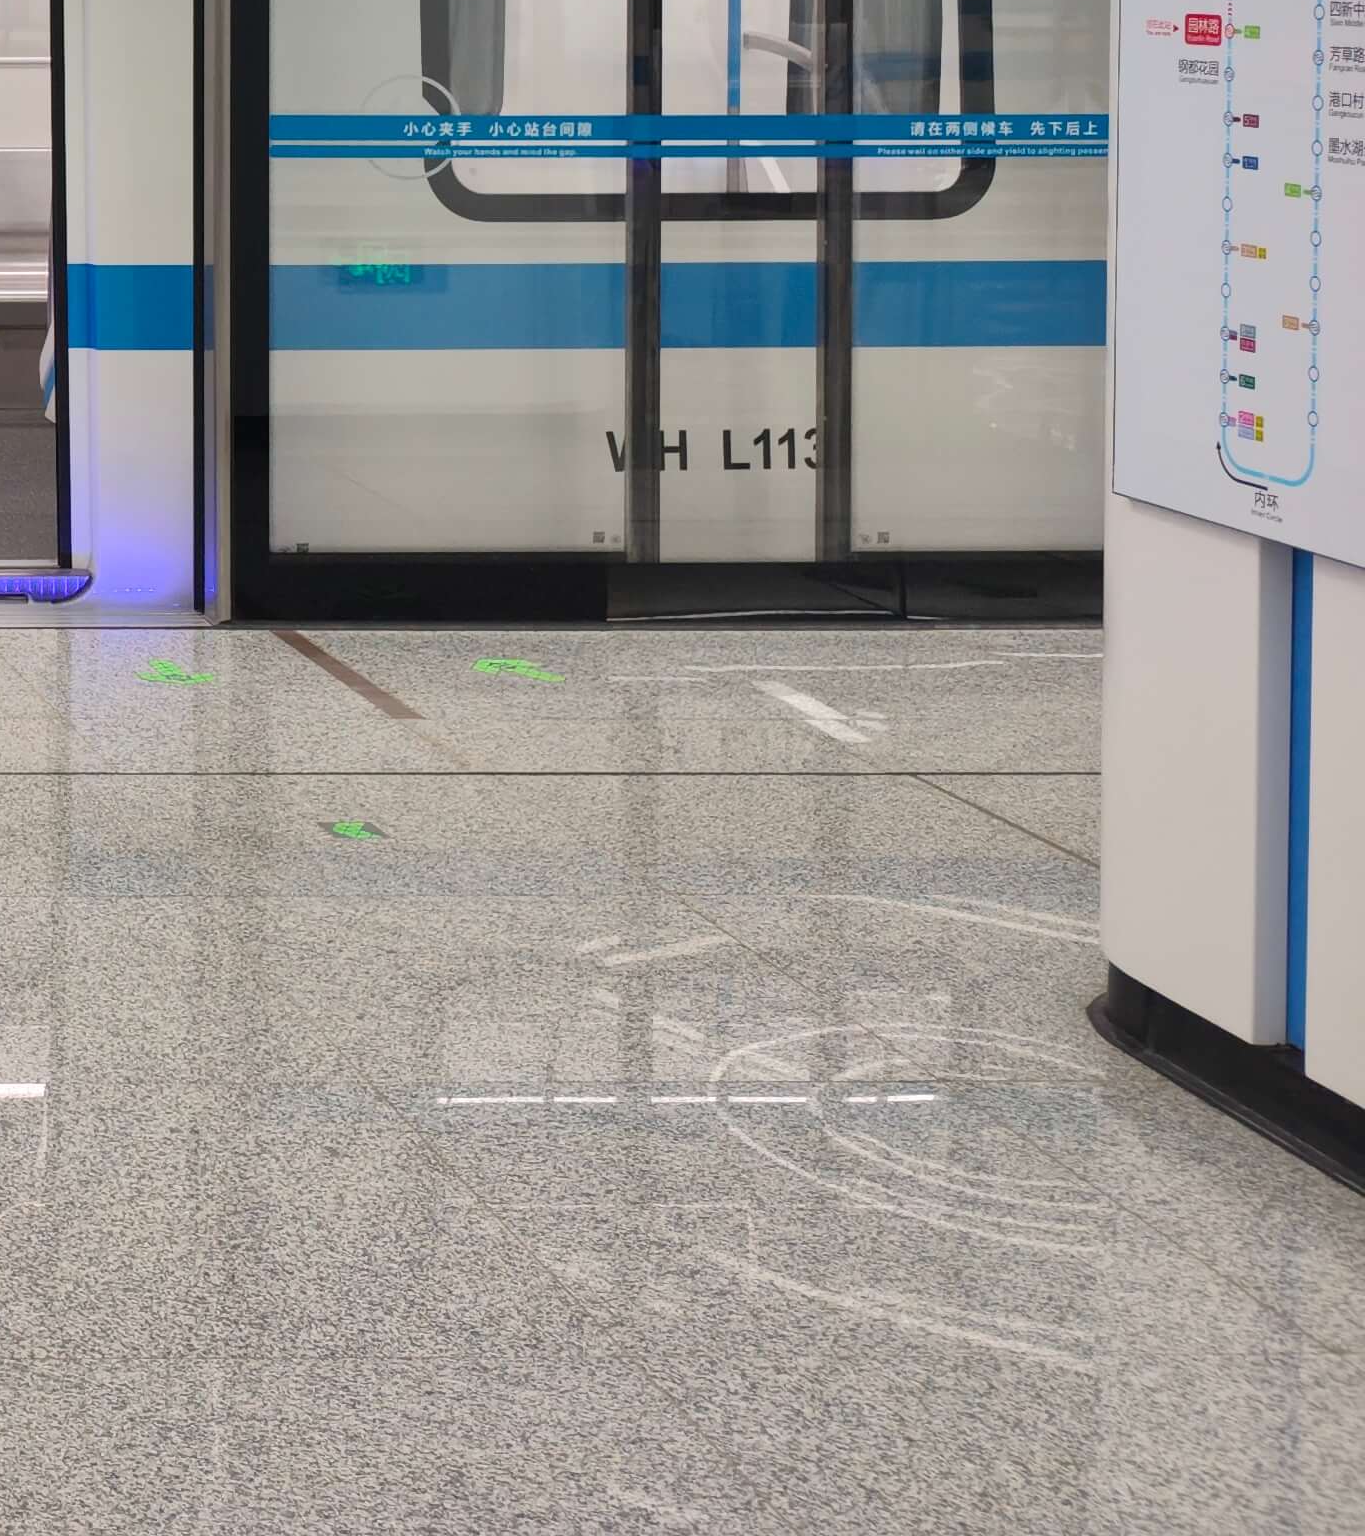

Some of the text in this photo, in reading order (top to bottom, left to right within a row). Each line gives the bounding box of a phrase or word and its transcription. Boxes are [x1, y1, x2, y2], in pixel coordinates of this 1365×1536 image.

[404, 121, 593, 137] 小心夹手 小心站台间隙
[910, 121, 1099, 137] 请在两侧候车 先下后上
[453, 148, 473, 157] your
